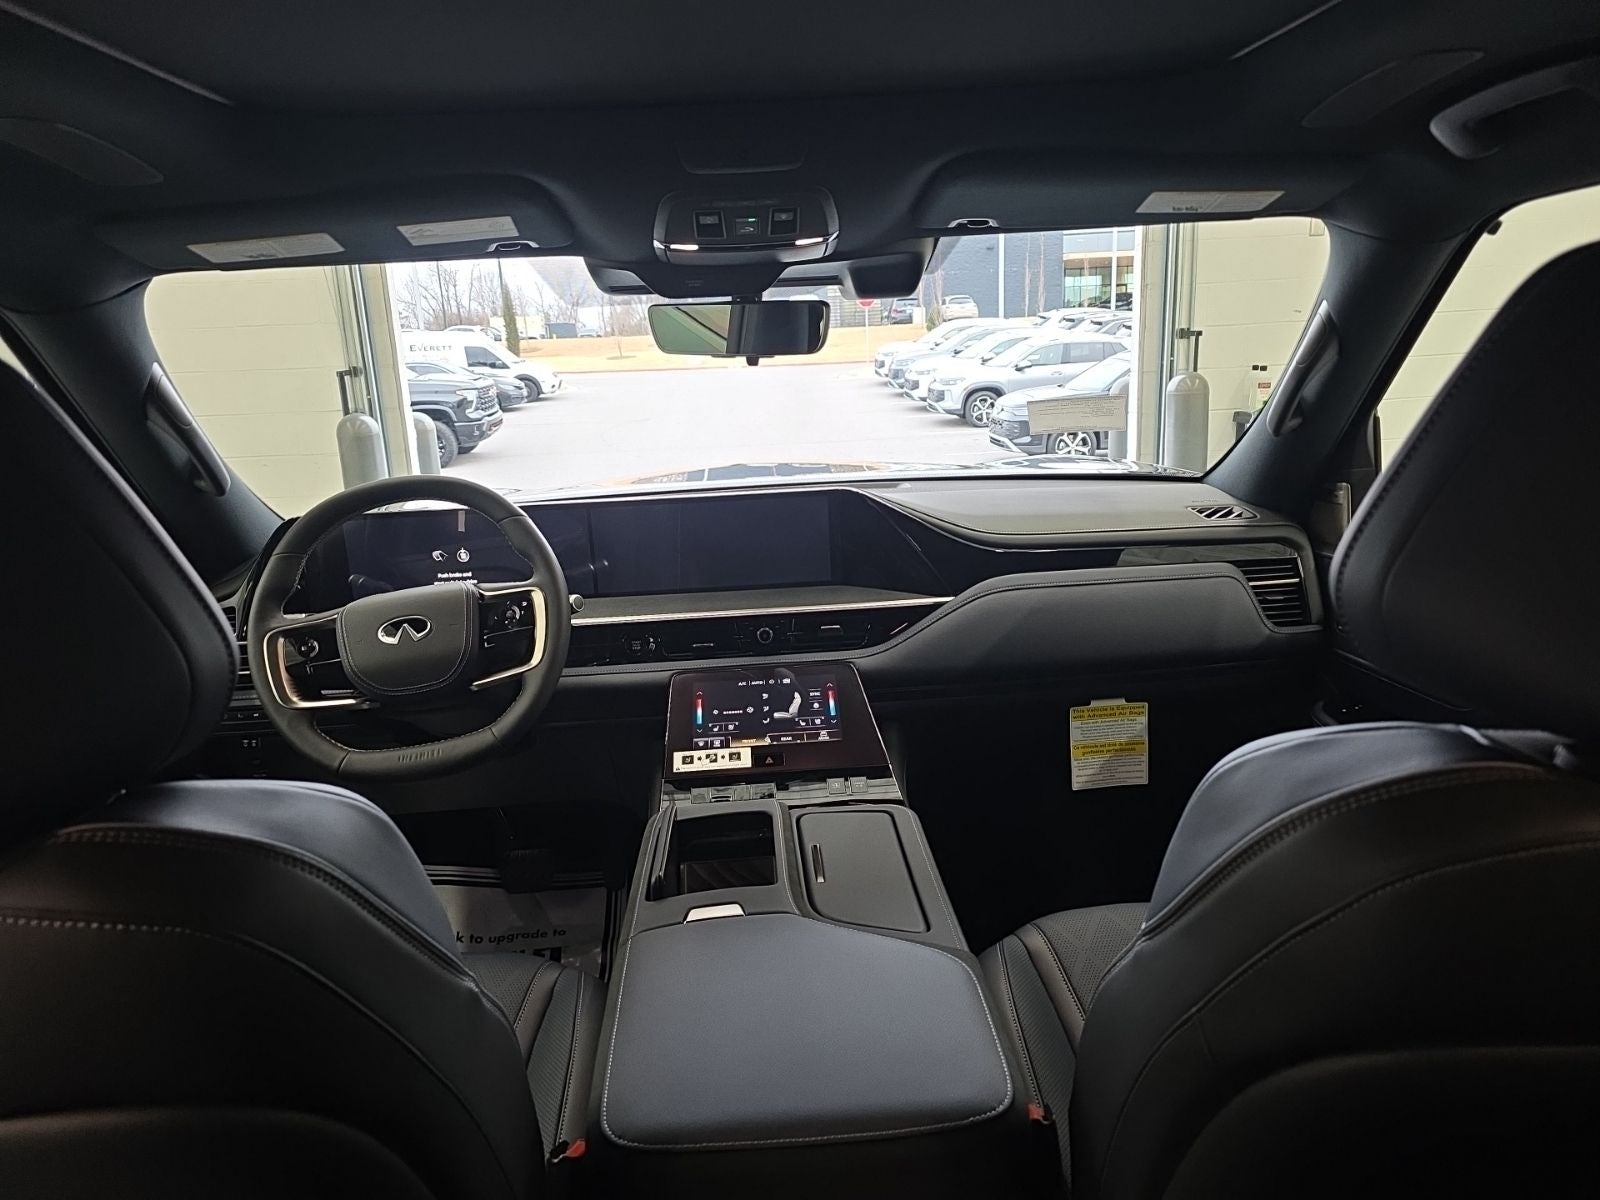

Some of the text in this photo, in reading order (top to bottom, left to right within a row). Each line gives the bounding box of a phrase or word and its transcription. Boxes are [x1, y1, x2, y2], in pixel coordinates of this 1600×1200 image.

[409, 344, 452, 352] EVERETT
[470, 934, 483, 944] to
[488, 929, 548, 945] upgrade
[553, 929, 566, 937] to
